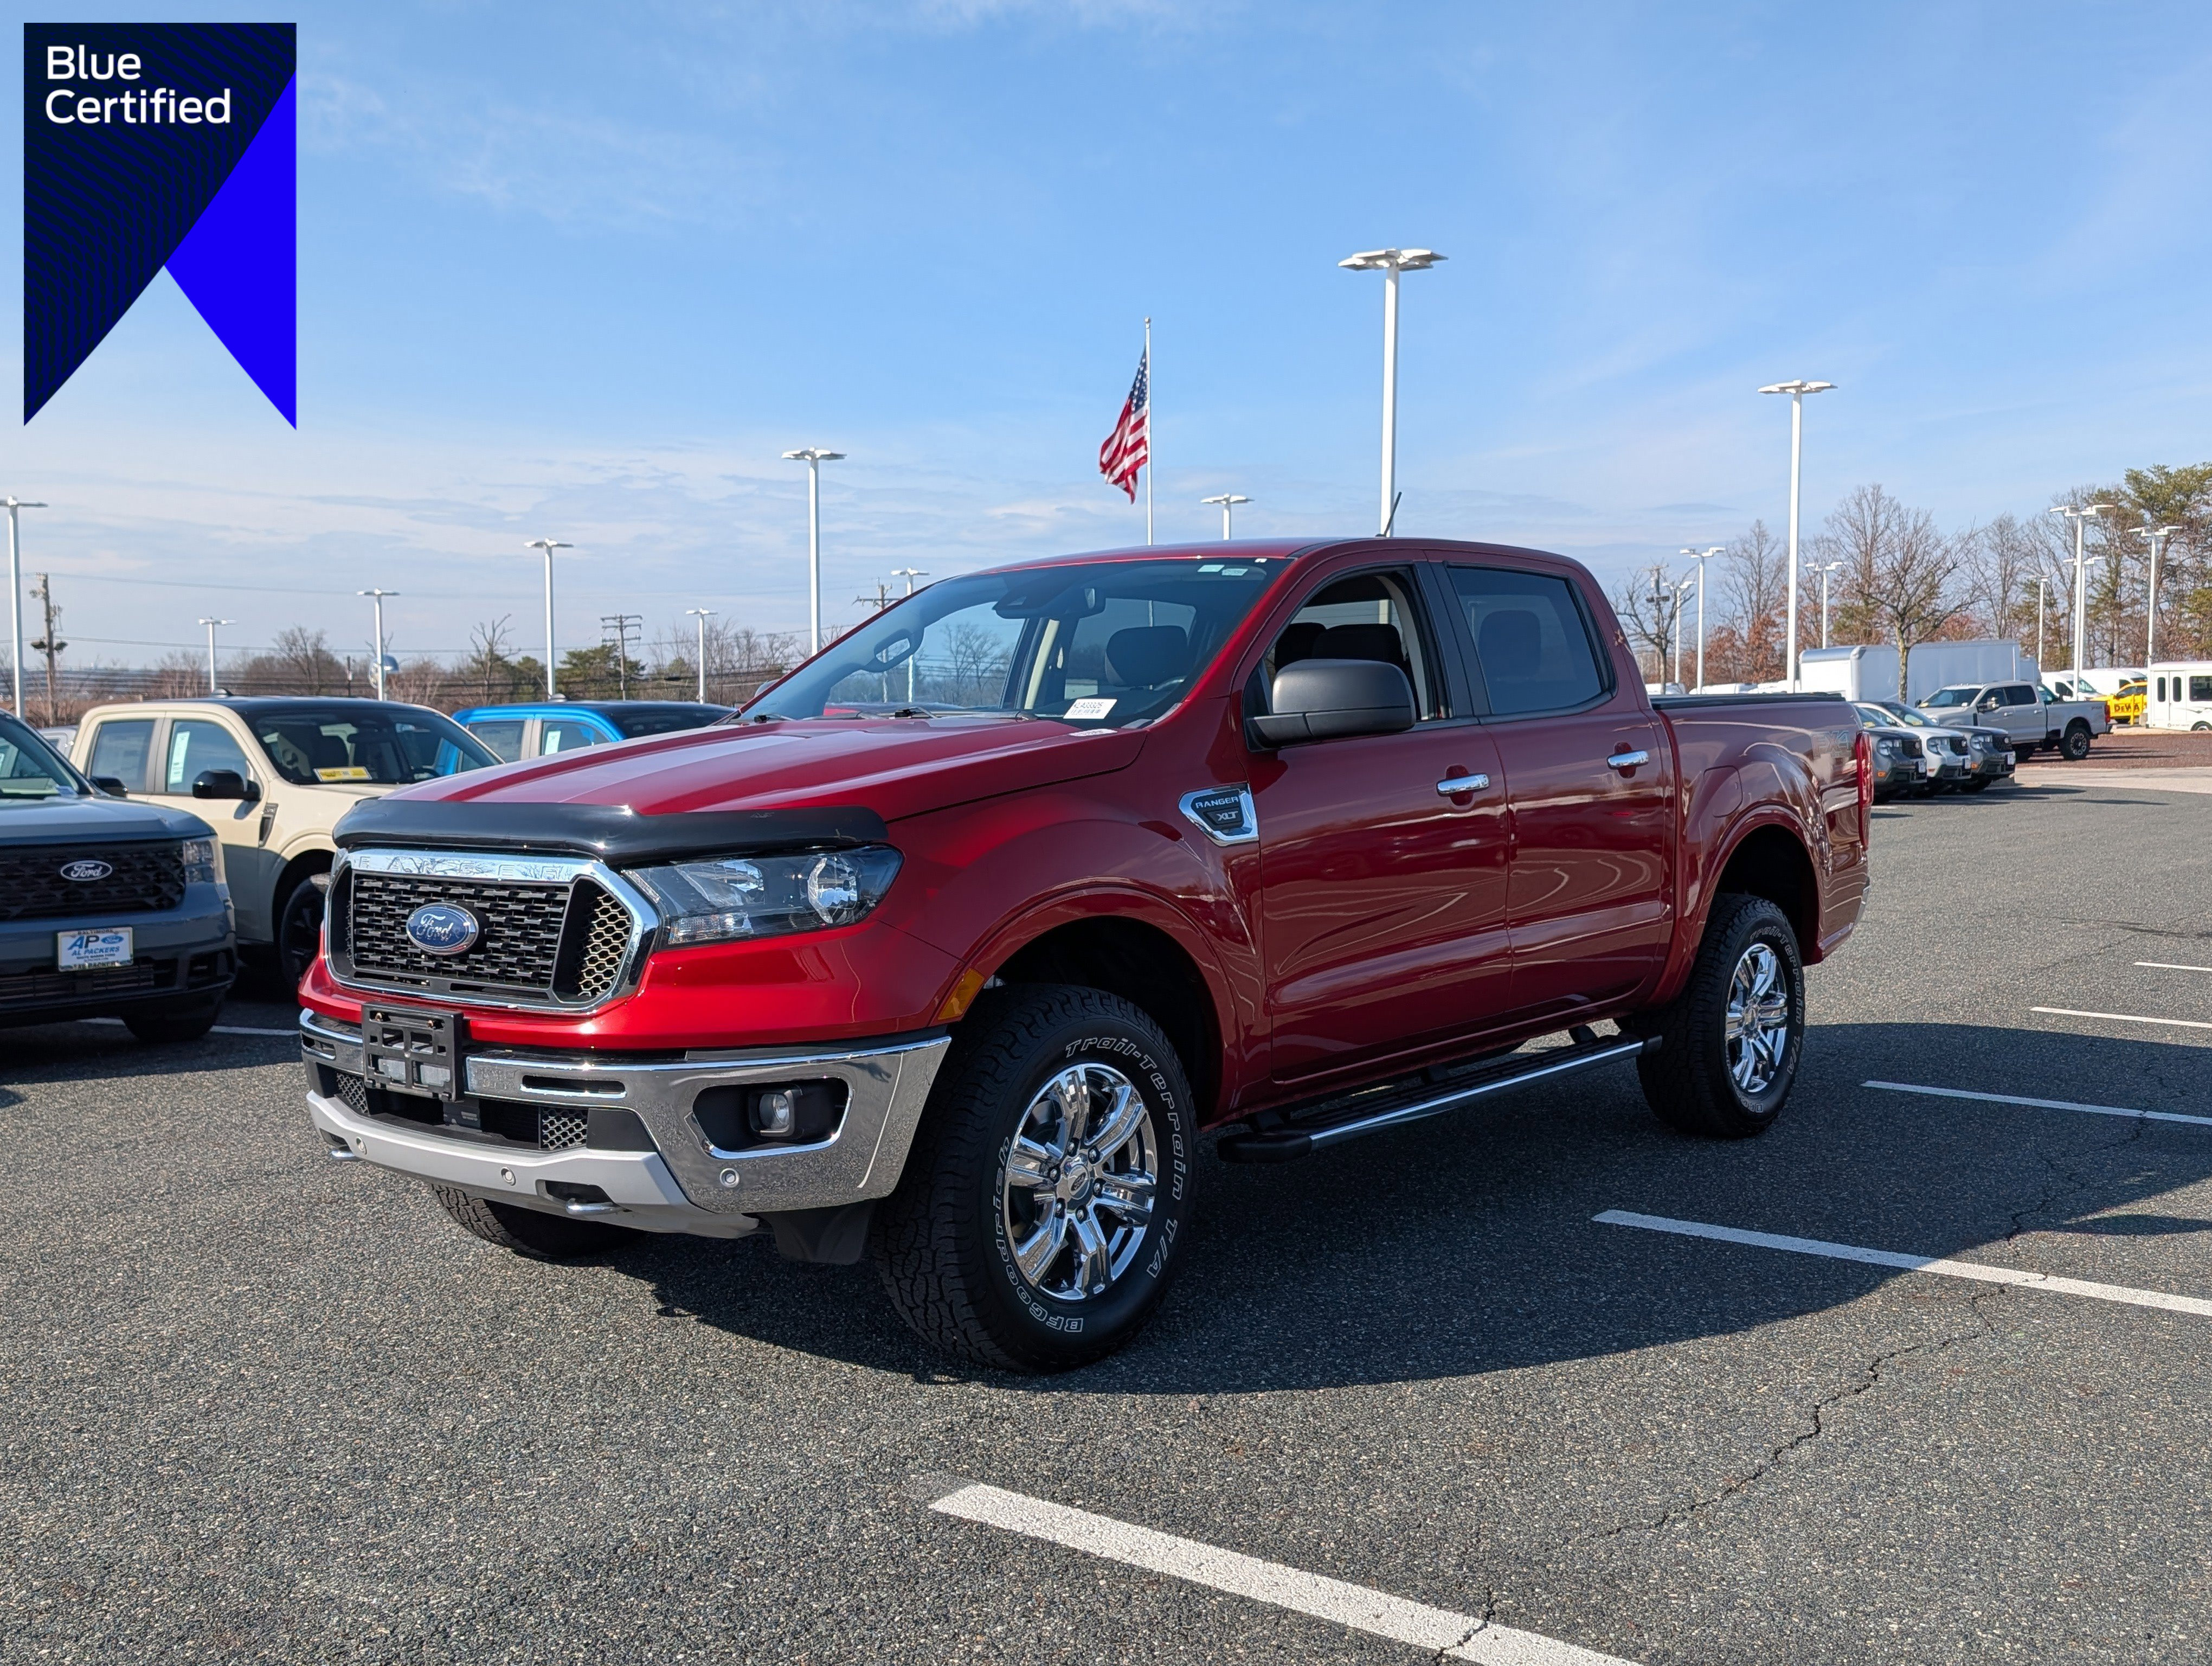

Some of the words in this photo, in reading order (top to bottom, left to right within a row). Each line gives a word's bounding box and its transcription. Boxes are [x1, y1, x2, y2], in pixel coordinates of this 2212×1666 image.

[1195, 796, 1239, 809] RANGER
[1216, 811, 1238, 822] XLT
[70, 863, 103, 877] Ford
[416, 913, 454, 939] Ford
[67, 935, 100, 950] AP
[1066, 1036, 1186, 1200] Trail-Terrain
[993, 1136, 1084, 1332] BFGoodrich
